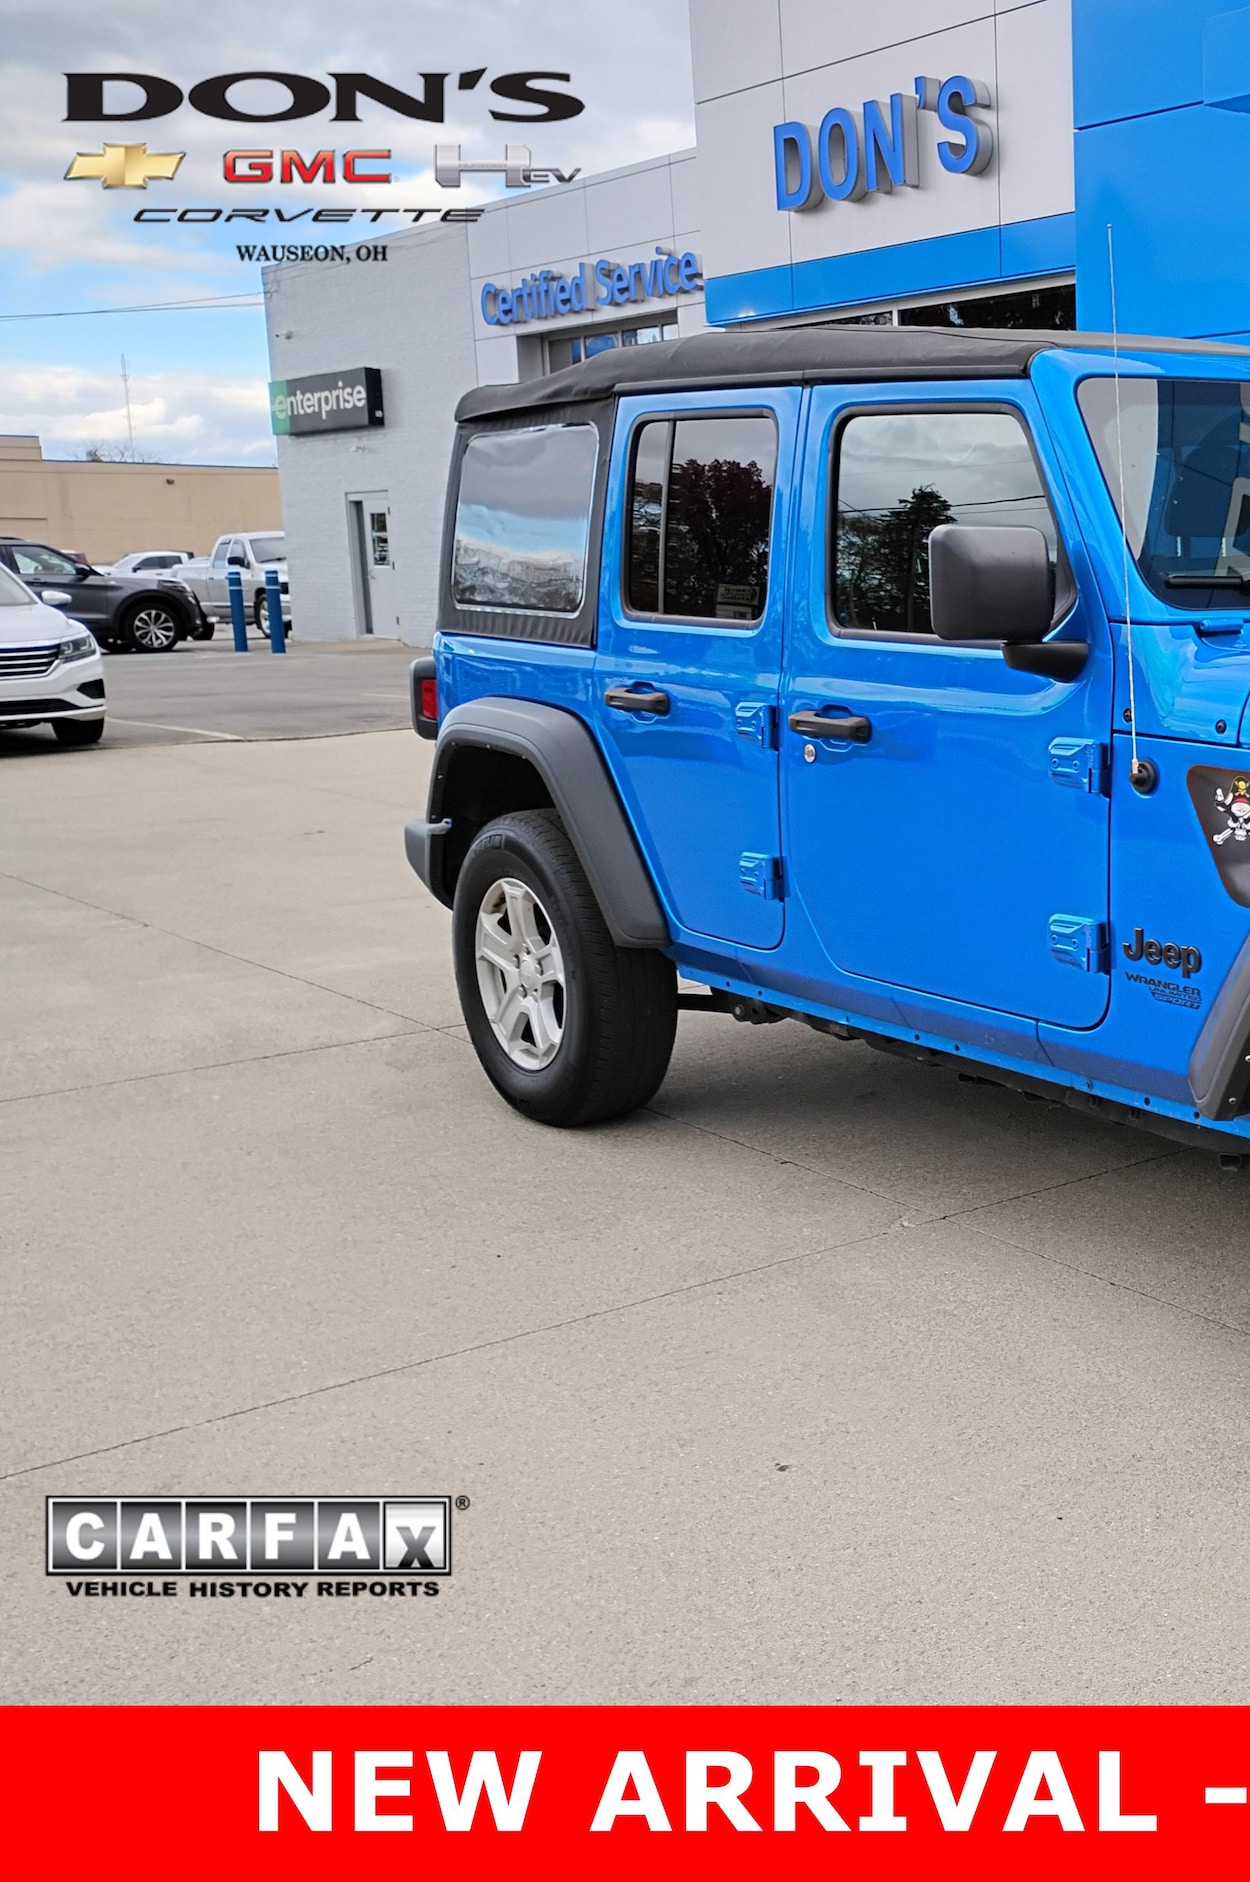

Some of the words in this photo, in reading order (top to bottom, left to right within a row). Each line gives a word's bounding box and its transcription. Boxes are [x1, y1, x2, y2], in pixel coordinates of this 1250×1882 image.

[773, 75, 984, 212] DON'S
[481, 262, 590, 327] Certified
[594, 246, 699, 306] Service
[273, 380, 367, 420] enterprise
[1123, 927, 1202, 979] Jeep
[1124, 971, 1201, 996] WRANGLER
[1153, 993, 1202, 1010] SPORT
